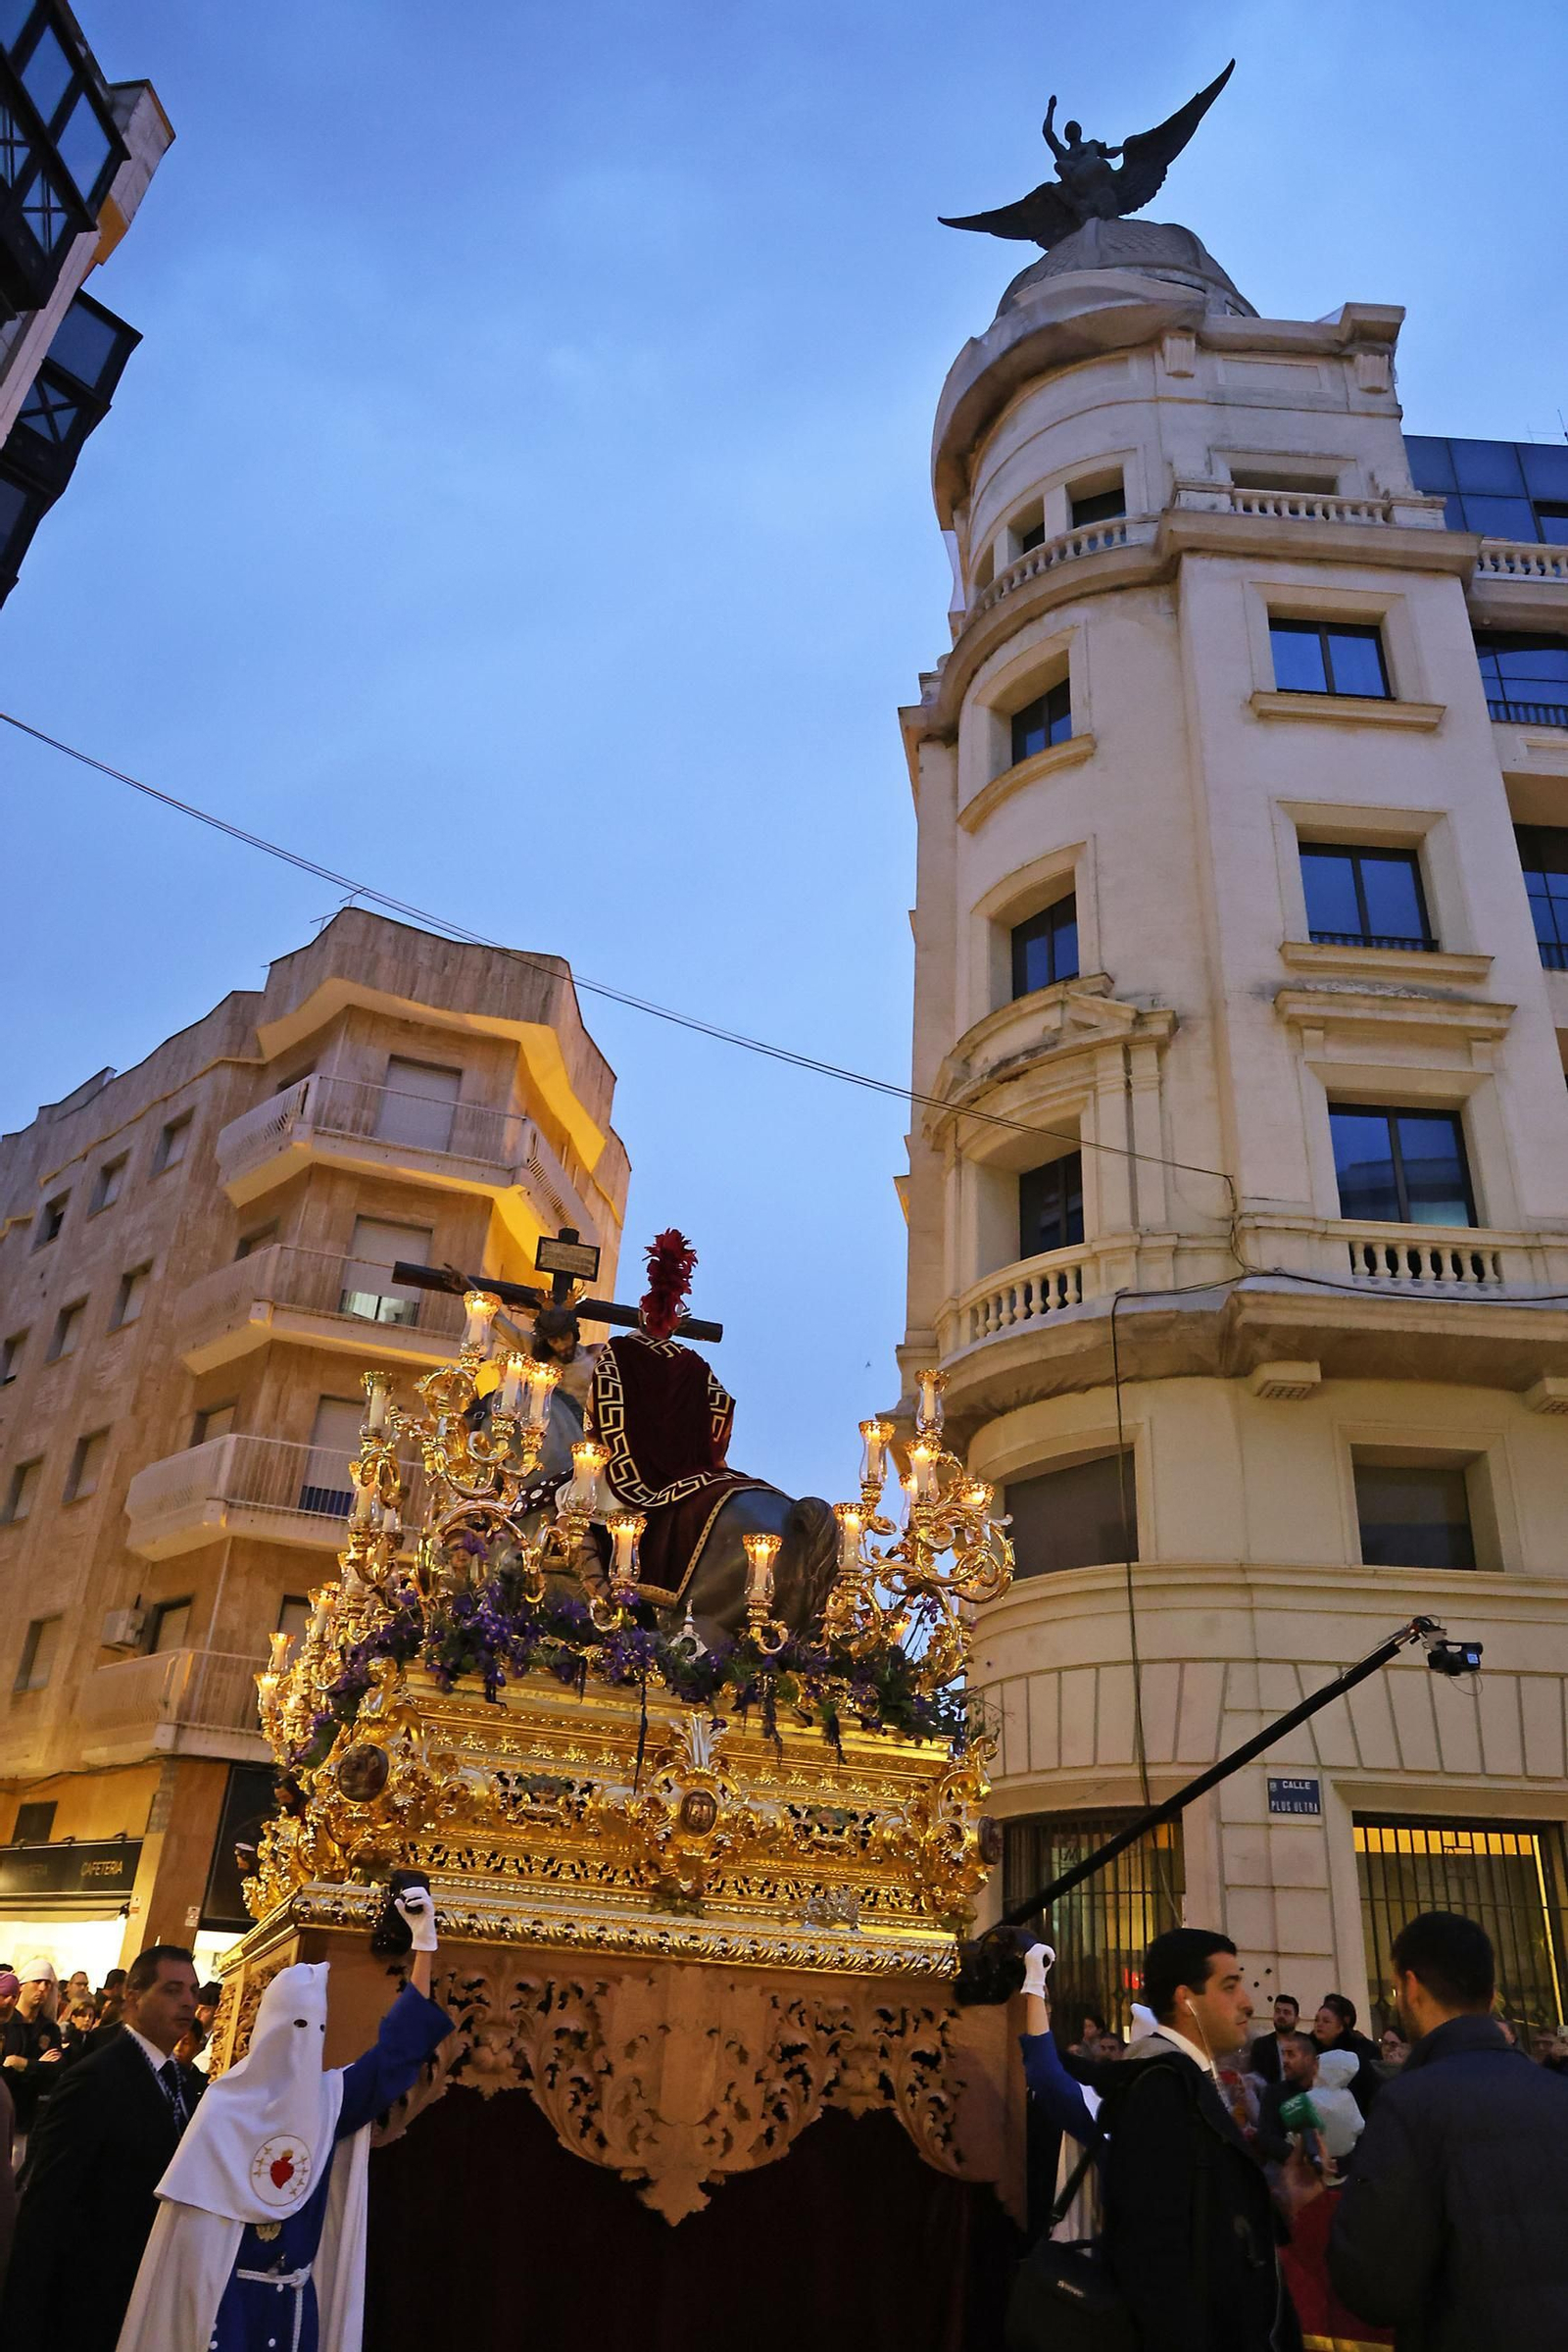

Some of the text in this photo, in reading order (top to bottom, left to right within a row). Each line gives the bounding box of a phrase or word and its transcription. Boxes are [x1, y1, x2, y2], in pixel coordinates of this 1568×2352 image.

[1282, 1780, 1311, 1790] CALLE
[1270, 1800, 1319, 1813] PLUS ULTRA
[80, 1860, 123, 1877] CAFETERIA
